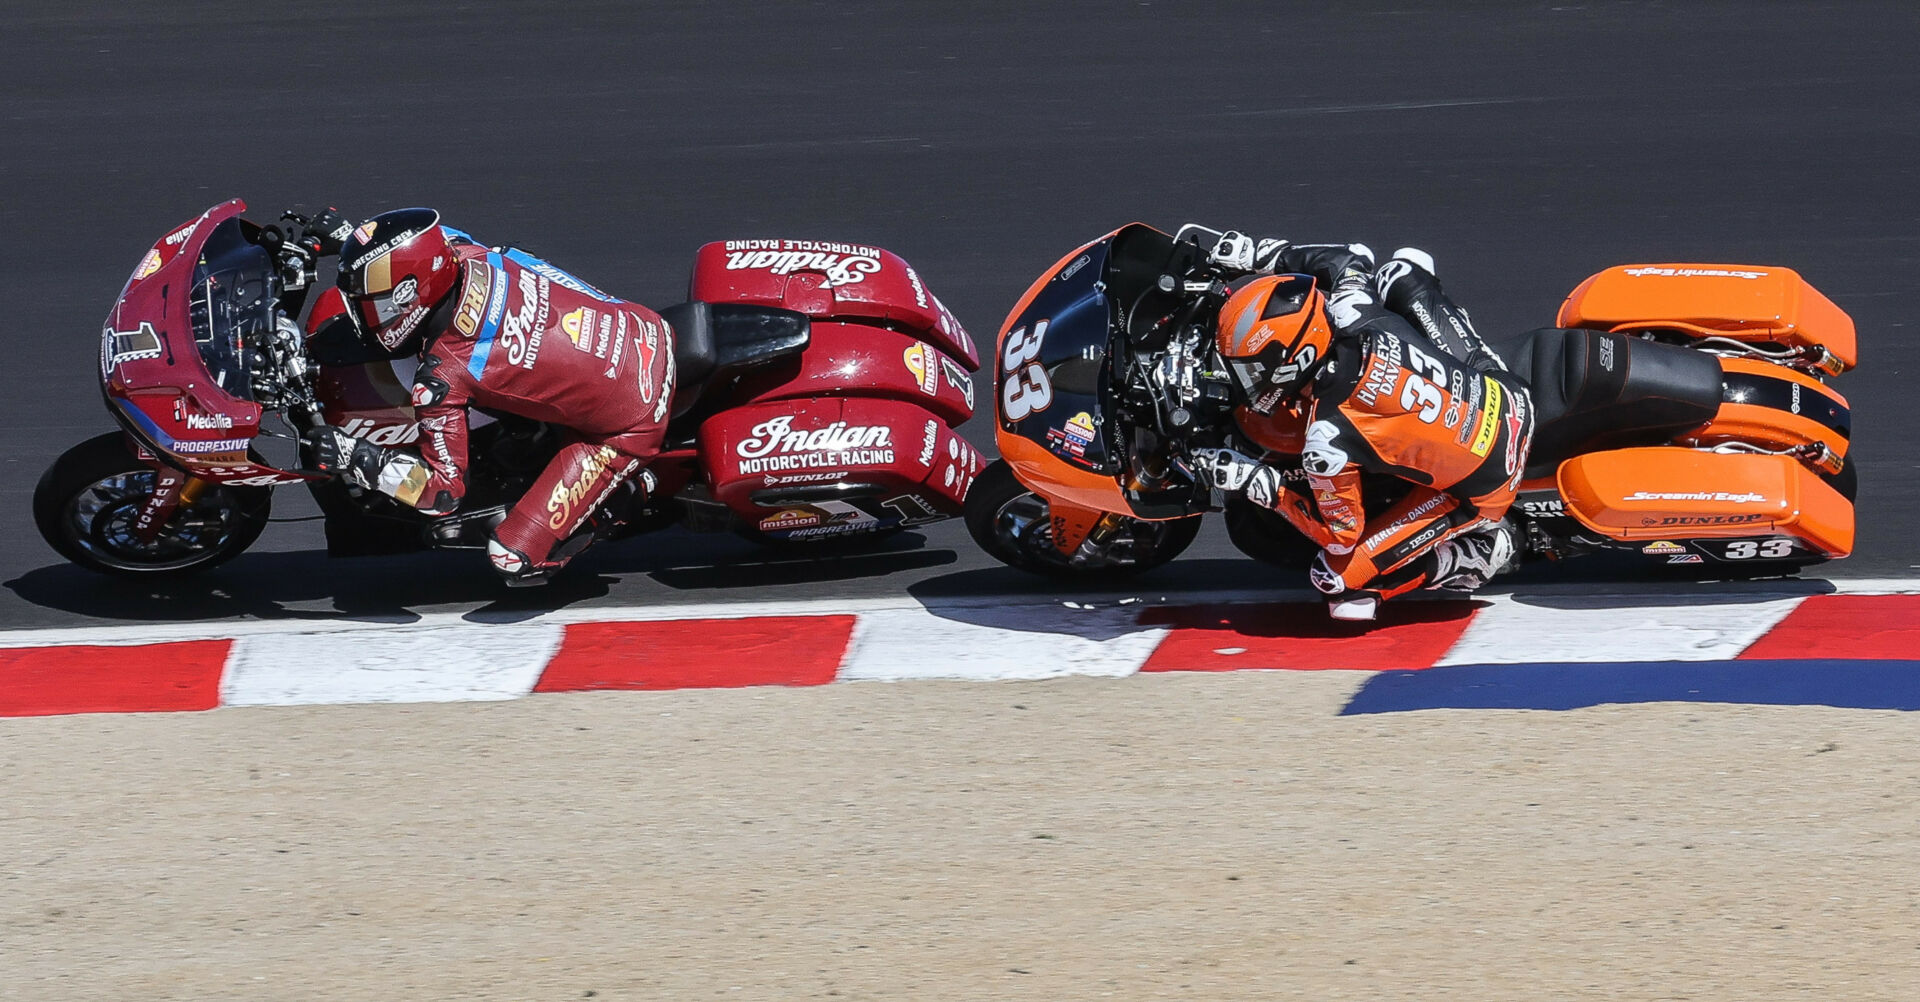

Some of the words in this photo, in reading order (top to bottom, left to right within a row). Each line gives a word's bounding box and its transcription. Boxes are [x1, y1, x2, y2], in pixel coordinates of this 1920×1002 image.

[351, 243, 390, 271] WRECKING
[390, 229, 414, 246] CREW
[725, 239, 779, 250] RACING
[783, 239, 881, 258] MOTORCYCLE
[384, 305, 423, 346] Indian
[522, 298, 549, 370] MOTORCYCLE
[595, 313, 612, 359] Medallia
[1003, 318, 1054, 421] 33
[1400, 343, 1448, 424] 33
[187, 413, 233, 429] Medallia
[173, 438, 250, 453] PROGRESSIVE
[918, 419, 938, 468] Medallia
[738, 451, 838, 475] MOTORCYCLE
[841, 449, 895, 465] RACING
[779, 472, 849, 484] DUNLOP
[1623, 491, 1714, 501] Screamin'
[1714, 492, 1766, 503] Eagle
[761, 516, 819, 529] mission
[788, 520, 878, 538] PROGRESSIVE
[1660, 513, 1762, 526] DUNLOP
[1725, 539, 1793, 559] 33
